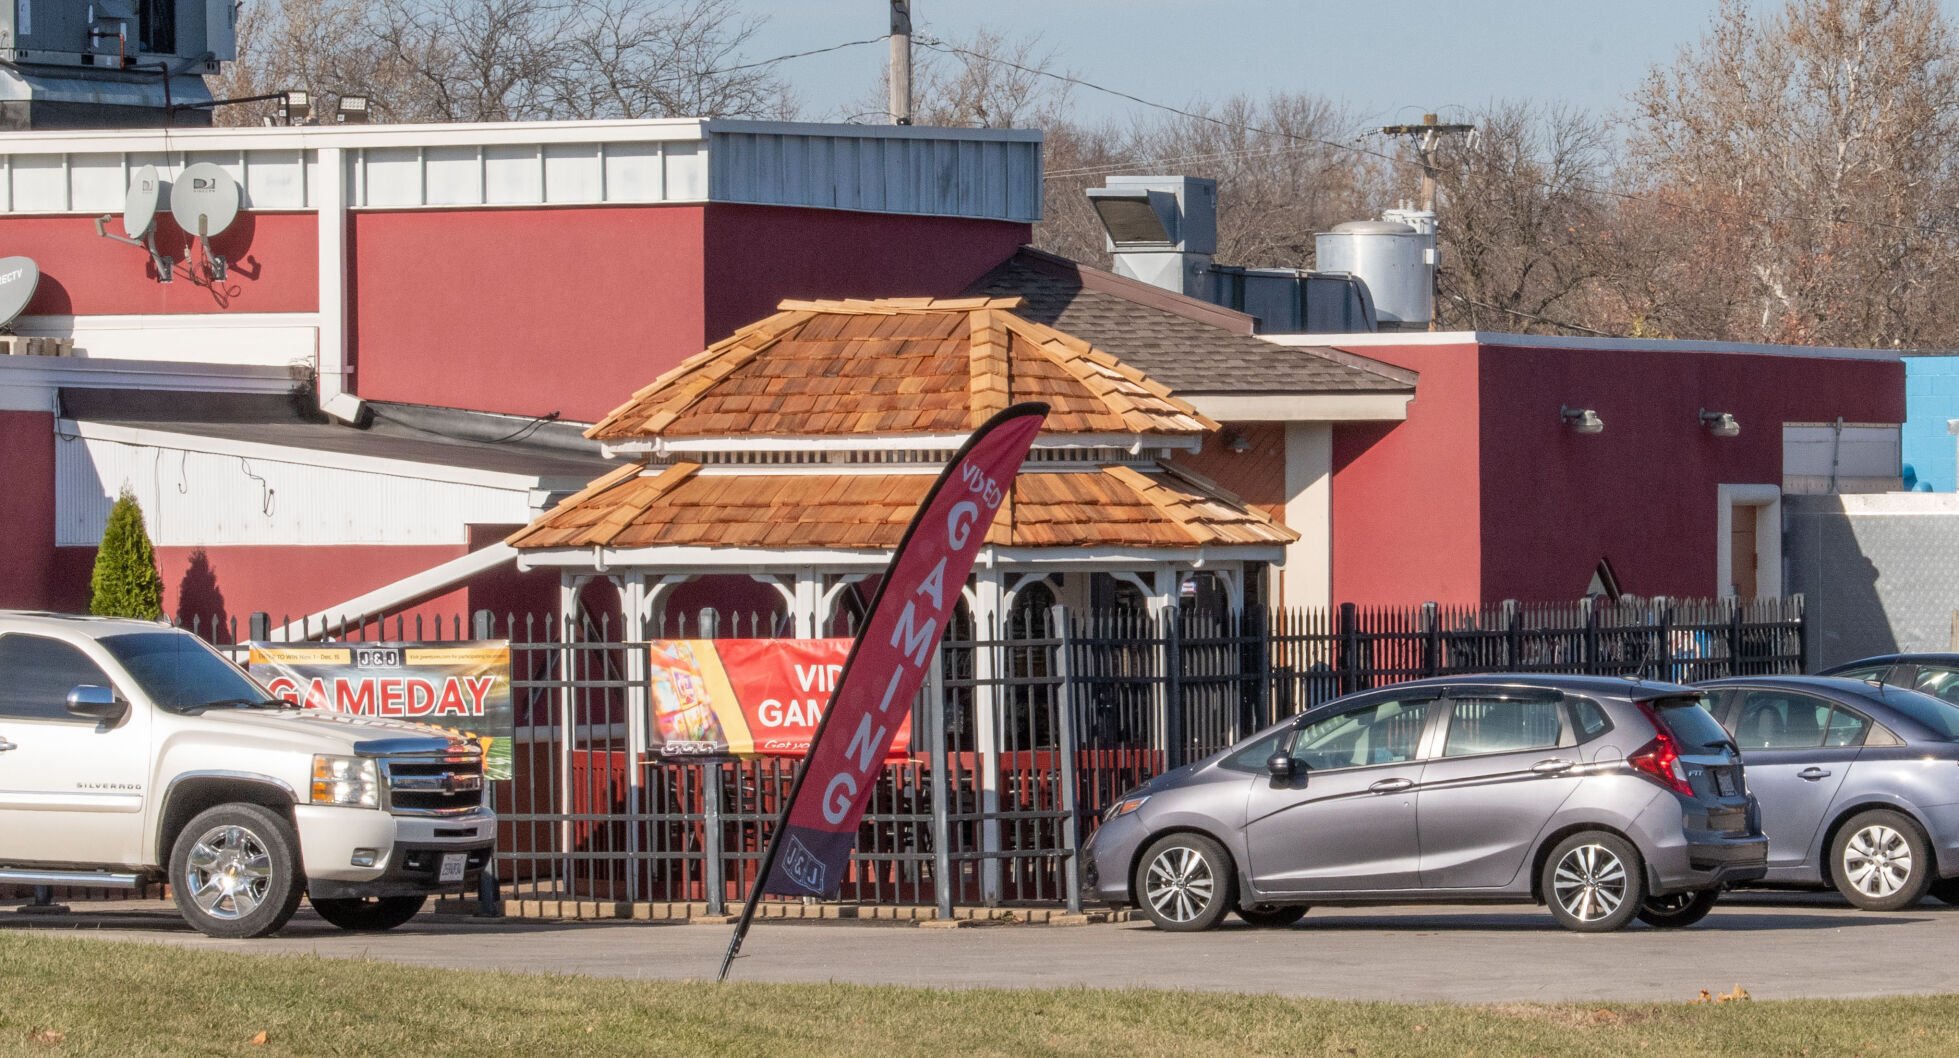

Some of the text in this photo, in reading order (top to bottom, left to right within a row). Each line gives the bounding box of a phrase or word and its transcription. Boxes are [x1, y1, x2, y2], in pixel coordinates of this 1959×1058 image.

[0, 267, 23, 285] ECTV
[962, 458, 1002, 509] VIDEO
[794, 664, 843, 692] VID
[822, 500, 979, 825] GAMING
[266, 675, 497, 717] GAMEDAY
[77, 782, 142, 790] SILVERADO
